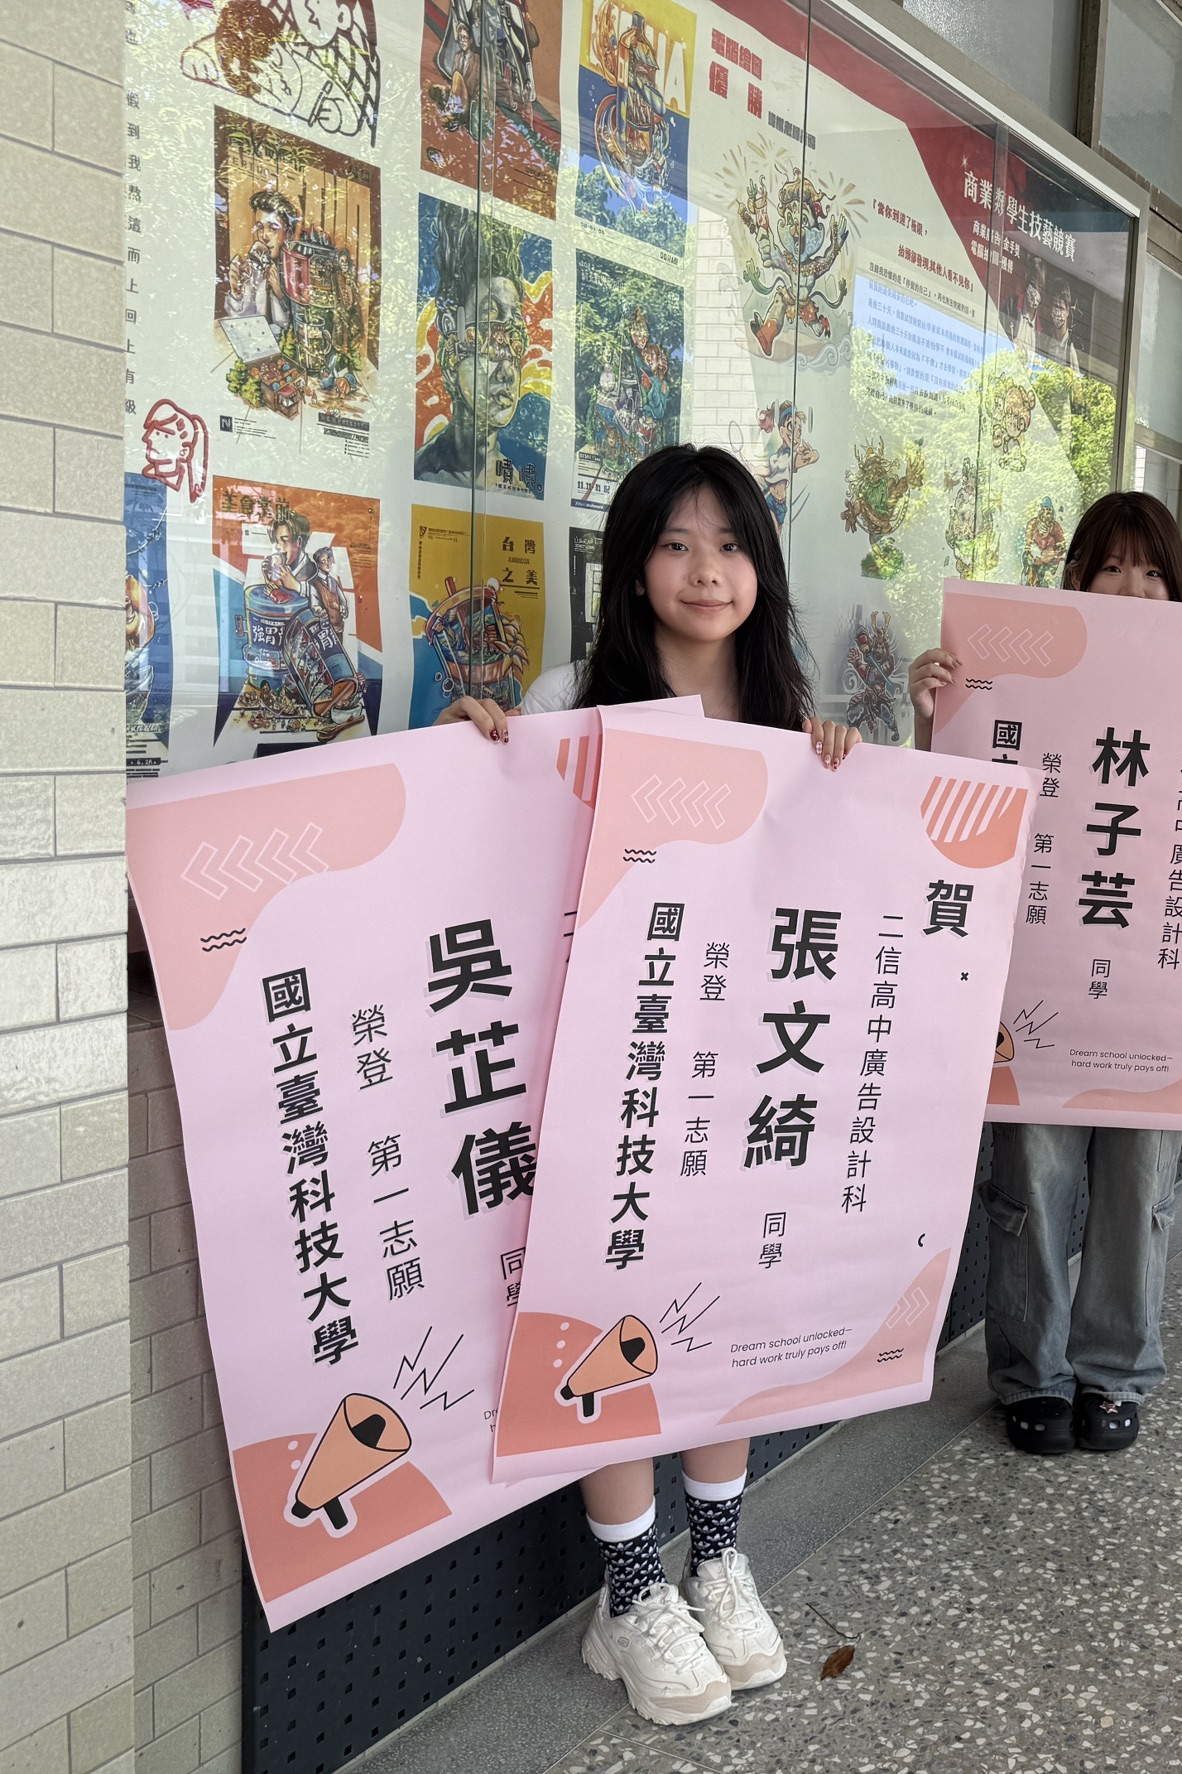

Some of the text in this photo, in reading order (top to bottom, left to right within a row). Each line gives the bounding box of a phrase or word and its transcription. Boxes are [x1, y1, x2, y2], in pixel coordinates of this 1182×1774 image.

[964, 170, 1075, 262] 商業類學生技藝競賽
[922, 879, 974, 938] 賀
[1025, 752, 1062, 924] 榮登 第一志願
[1078, 726, 1151, 1000] 林子芸 同學
[262, 967, 362, 1366] 國立臺灣科技大學
[352, 1004, 425, 1301] 榮登 第一志願
[427, 918, 537, 1216] 吳芷儀
[605, 902, 688, 1270] 國立臺灣科技大學
[680, 941, 729, 1177] 榮登 第一志願
[743, 907, 842, 1269] 張文綺 同學
[841, 915, 904, 1214] 二信高中廣告設計科
[1069, 1048, 1098, 1057] Dream
[1100, 1051, 1128, 1059] school
[1071, 1060, 1091, 1068] hard
[1114, 1063, 1132, 1071] truly
[1134, 1064, 1154, 1073] pays
[730, 1340, 766, 1353] Dream
[768, 1335, 801, 1349] school
[731, 1357, 758, 1368] hard
[759, 1352, 782, 1365] work
[785, 1349, 805, 1360] truly
[807, 1345, 830, 1358] pays
